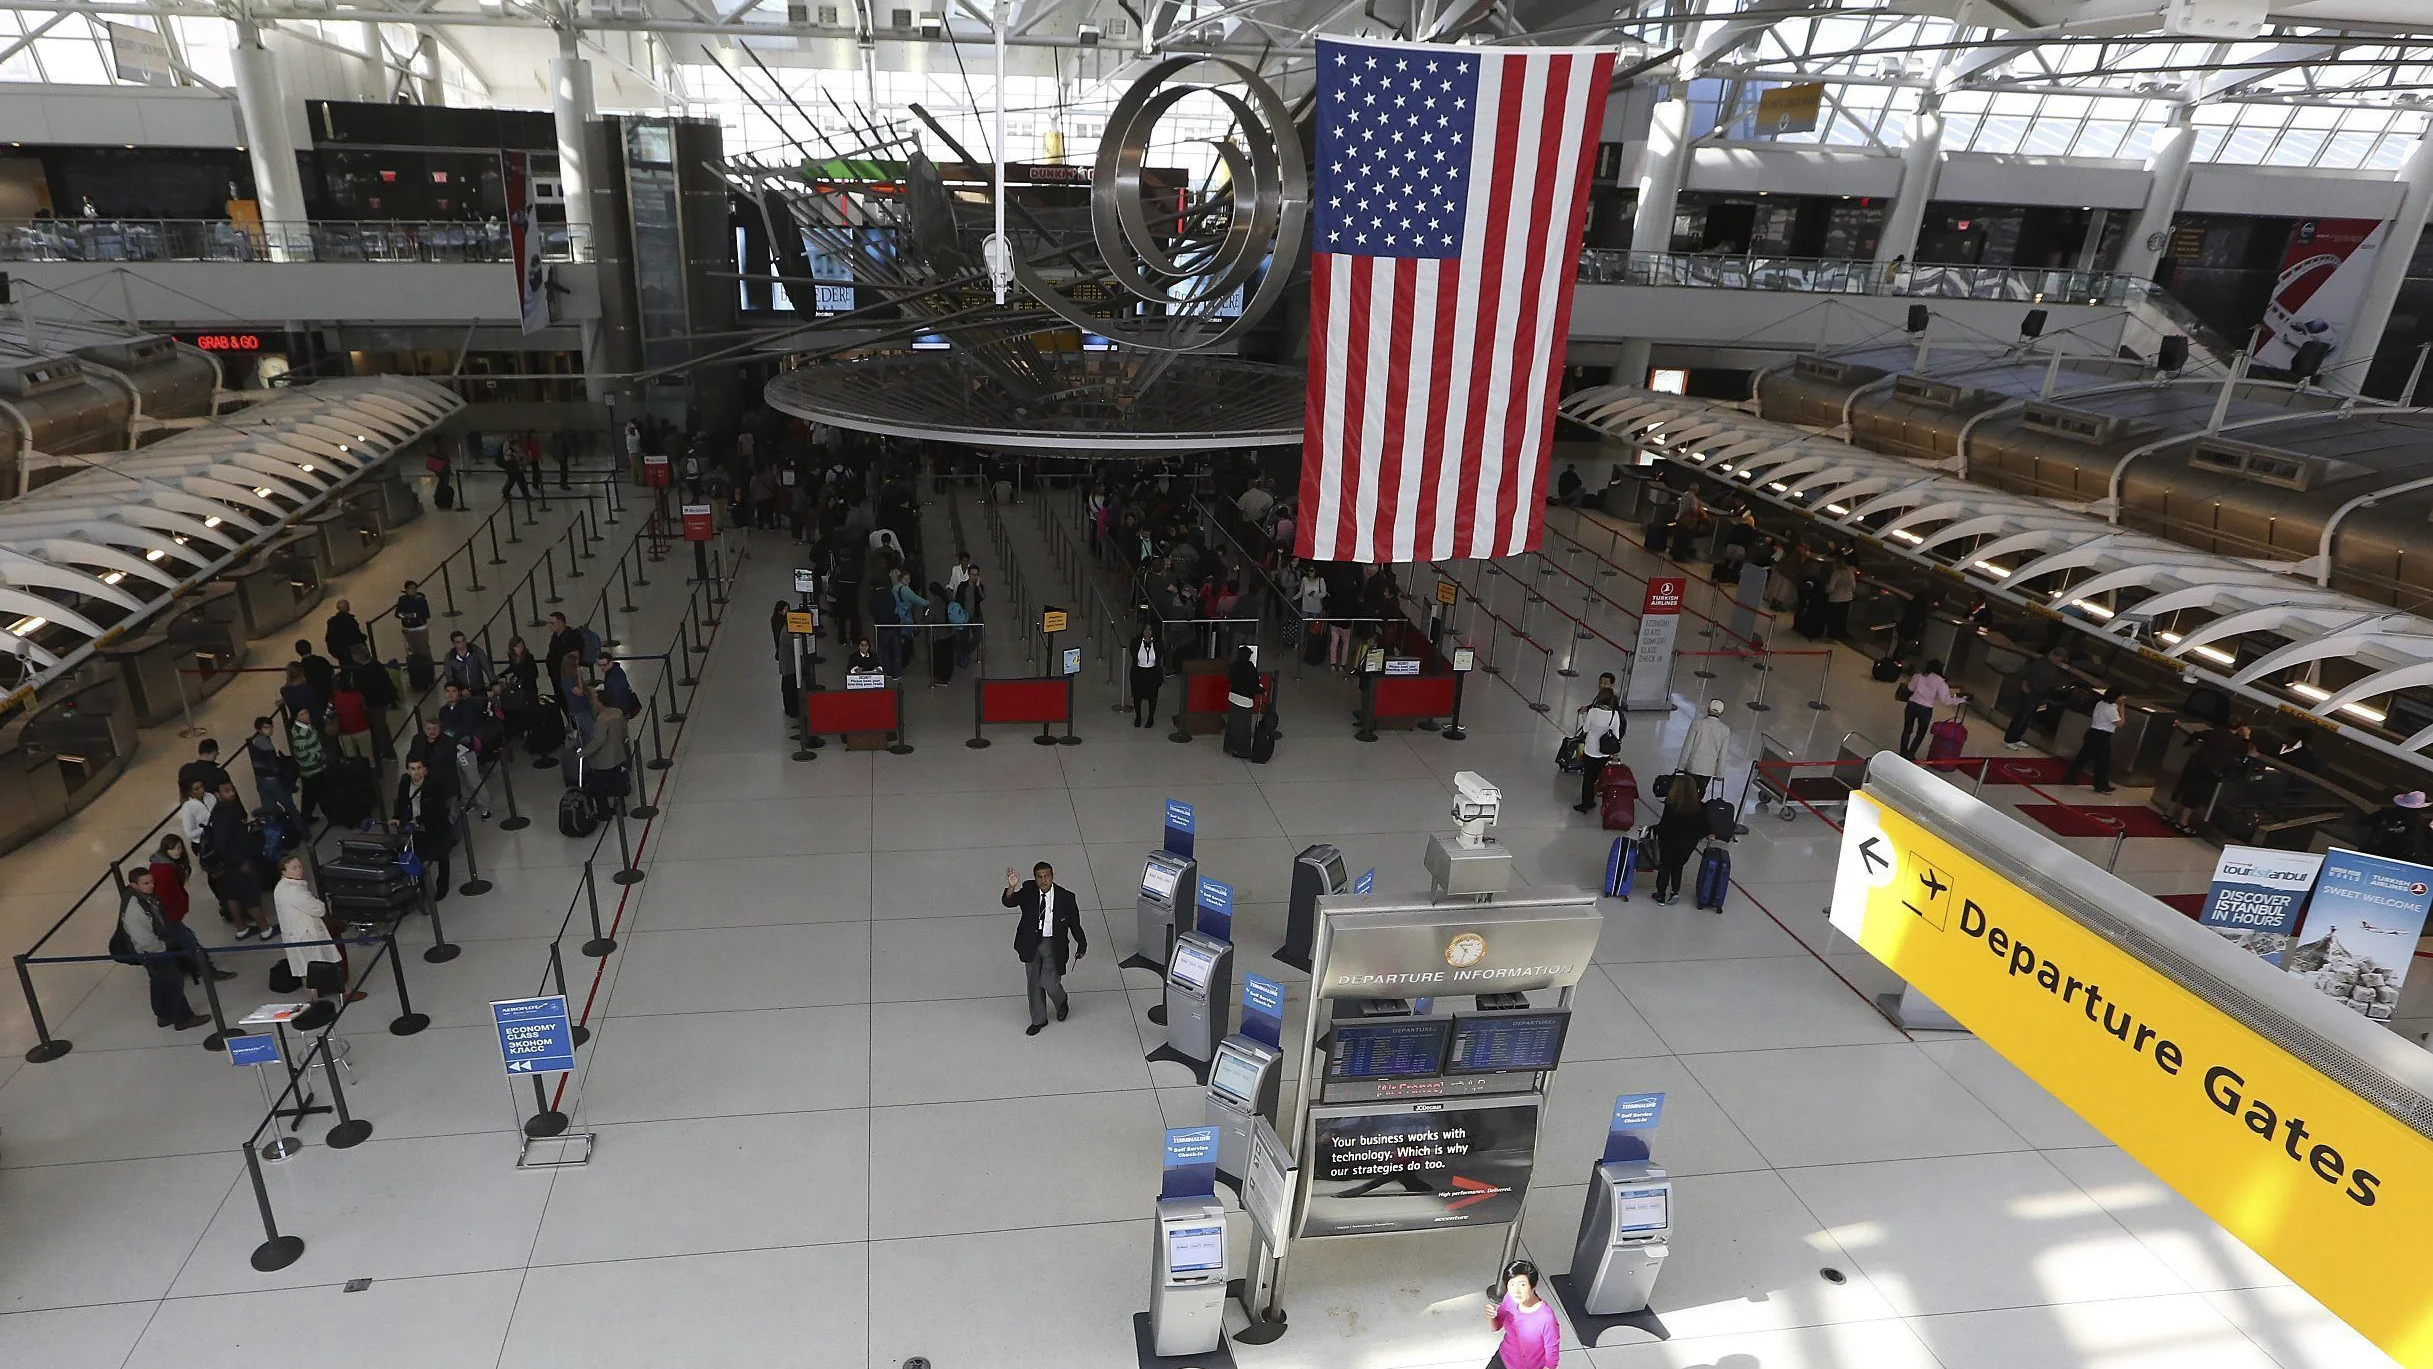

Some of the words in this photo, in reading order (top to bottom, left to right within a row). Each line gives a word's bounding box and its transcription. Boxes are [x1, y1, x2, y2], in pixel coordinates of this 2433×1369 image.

[197, 335, 229, 349] GRAB
[230, 336, 239, 349] &
[240, 335, 258, 349] GO
[2370, 880, 2409, 892] AIRLINES
[2372, 874, 2411, 886] TURKISH
[2219, 889, 2291, 906] DISCOVER
[2323, 885, 2362, 899] SWEET
[2363, 893, 2422, 912] WELCOME
[2215, 899, 2286, 917] ISTANBUL
[2211, 909, 2229, 921] IN
[2232, 912, 2285, 926] HOURS
[1338, 971, 1446, 986] DEPARTURE
[1453, 963, 1574, 981] INFORMATION
[1259, 994, 1276, 1005] Service
[505, 1024, 556, 1034] ECONOMY
[507, 1031, 539, 1040] CLASS
[508, 1039, 552, 1048] ЭКОНОМ
[510, 1046, 545, 1054] КЛАСС
[1959, 898, 2183, 1076] Departure
[2203, 1065, 2381, 1207] Gates
[1332, 1136, 1357, 1148] Your
[1360, 1133, 1404, 1146] business
[1407, 1130, 1439, 1142] works
[1442, 1127, 1466, 1140] with
[1331, 1149, 1393, 1163] technology.
[1397, 1146, 1431, 1158] Which
[1434, 1144, 1443, 1155] is
[1447, 1143, 1469, 1156] why
[1330, 1167, 1349, 1177] our
[1352, 1163, 1404, 1175] strategies
[1407, 1160, 1421, 1171] do
[1424, 1159, 1446, 1170] too.
[1451, 1188, 1486, 1198] performance.
[1487, 1186, 1513, 1194] Delivered.
[1434, 1214, 1470, 1222] accenture
